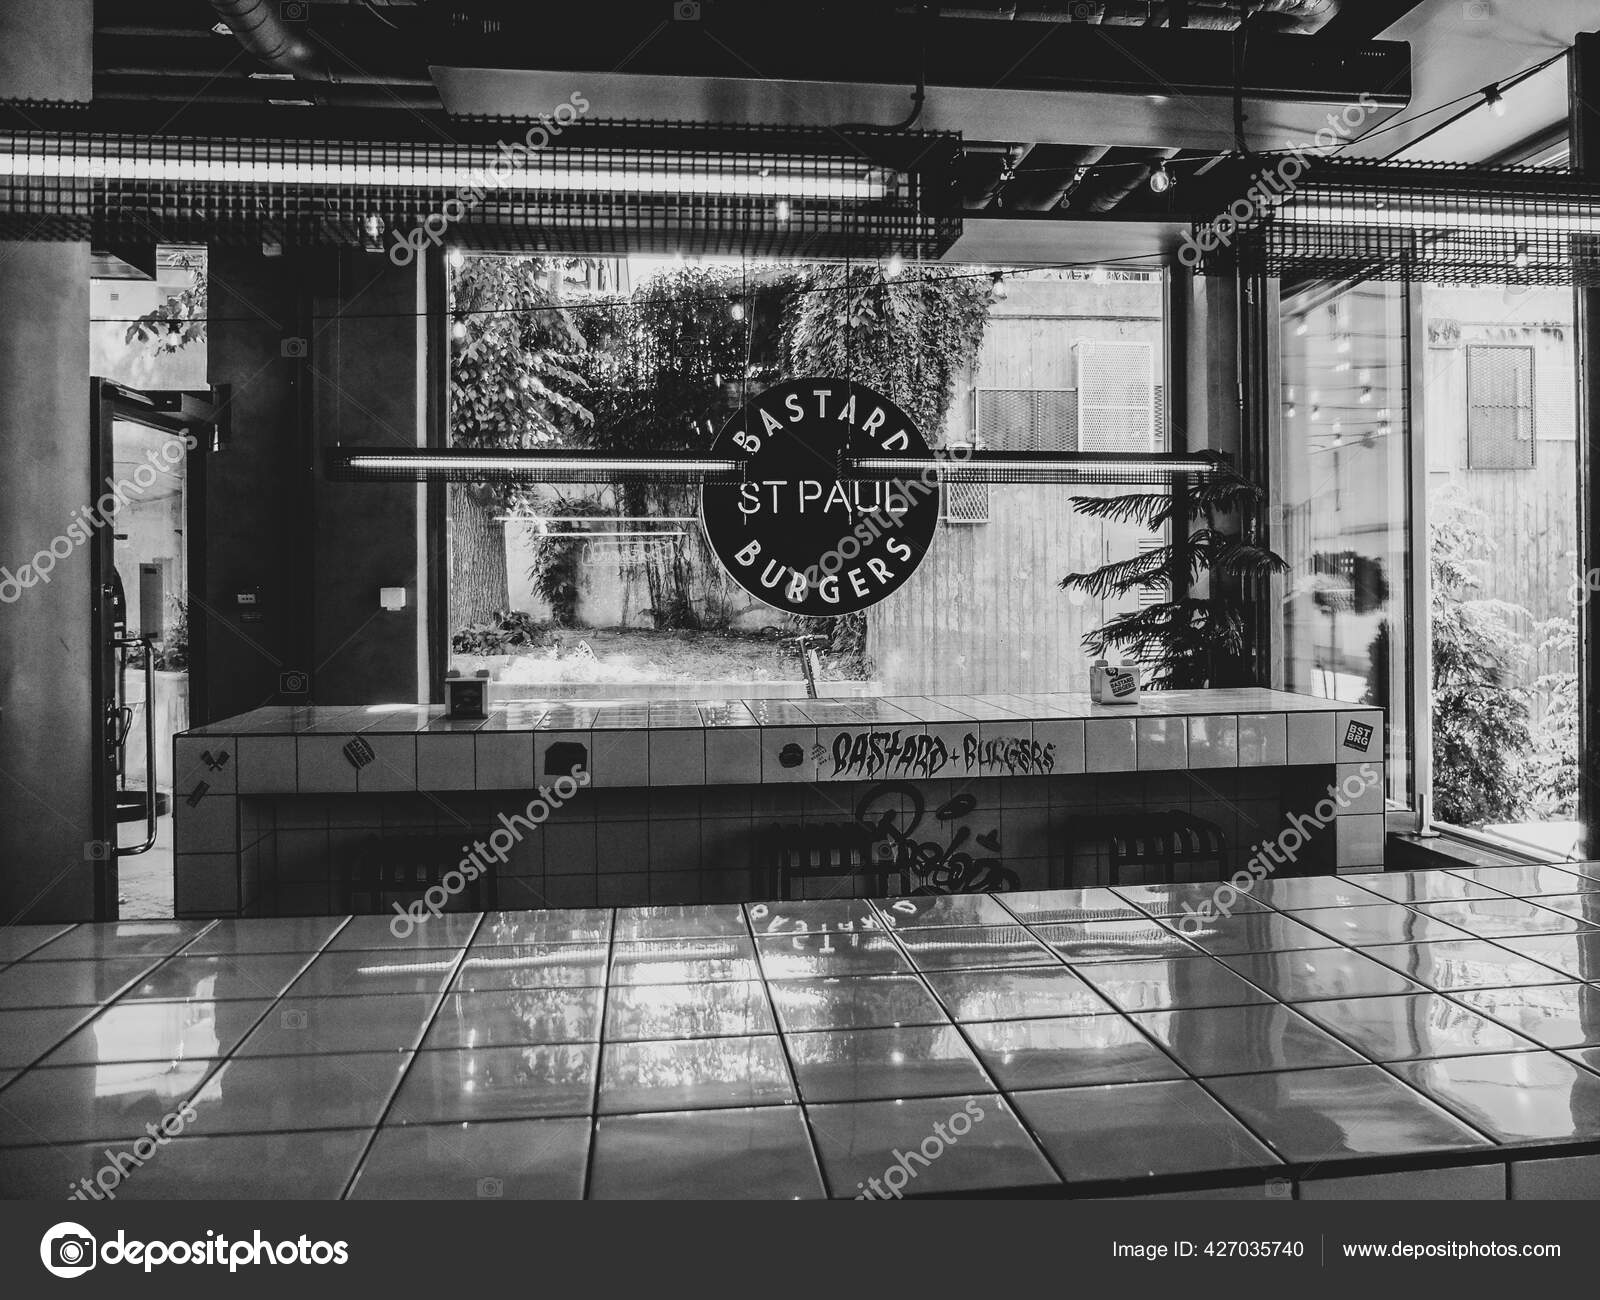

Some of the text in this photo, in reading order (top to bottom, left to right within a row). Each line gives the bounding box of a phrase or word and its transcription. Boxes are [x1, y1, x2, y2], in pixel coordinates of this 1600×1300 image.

[732, 390, 909, 454] BASTARD
[737, 480, 908, 514] ST PAUL
[734, 537, 912, 604] BURGERS
[1347, 732, 1368, 745] BRG
[1350, 724, 1371, 737] BST
